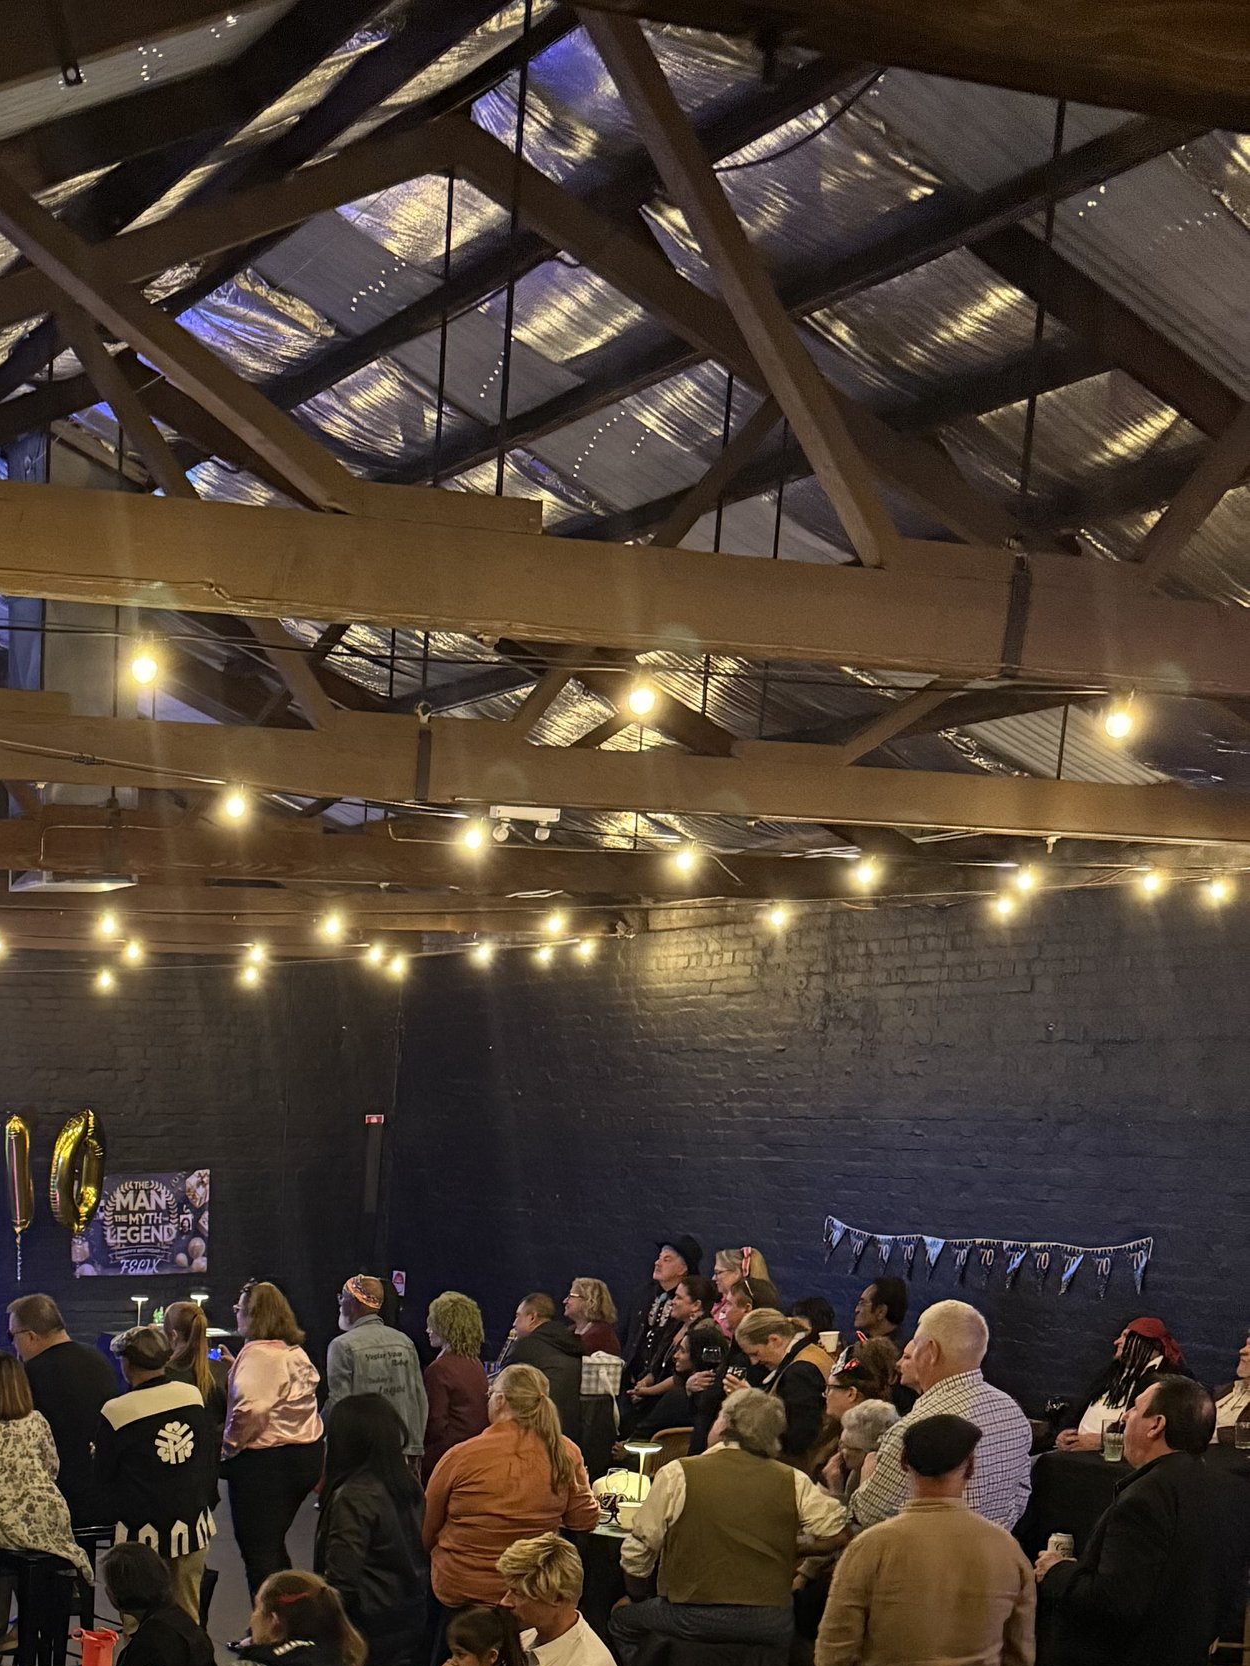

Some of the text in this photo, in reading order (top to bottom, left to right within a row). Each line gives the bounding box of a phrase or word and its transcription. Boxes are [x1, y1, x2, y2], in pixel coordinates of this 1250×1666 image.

[134, 1181, 150, 1190] THE
[115, 1190, 167, 1211] MAN
[129, 1213, 162, 1225] MYTH
[105, 1225, 177, 1243] LEGEND
[852, 1240, 864, 1256] 70
[903, 1244, 915, 1260] 70
[956, 1249, 967, 1265] 70
[981, 1249, 994, 1265] 70
[1036, 1252, 1049, 1269] 70
[1130, 1250, 1145, 1269] 70
[1096, 1257, 1110, 1275] 70
